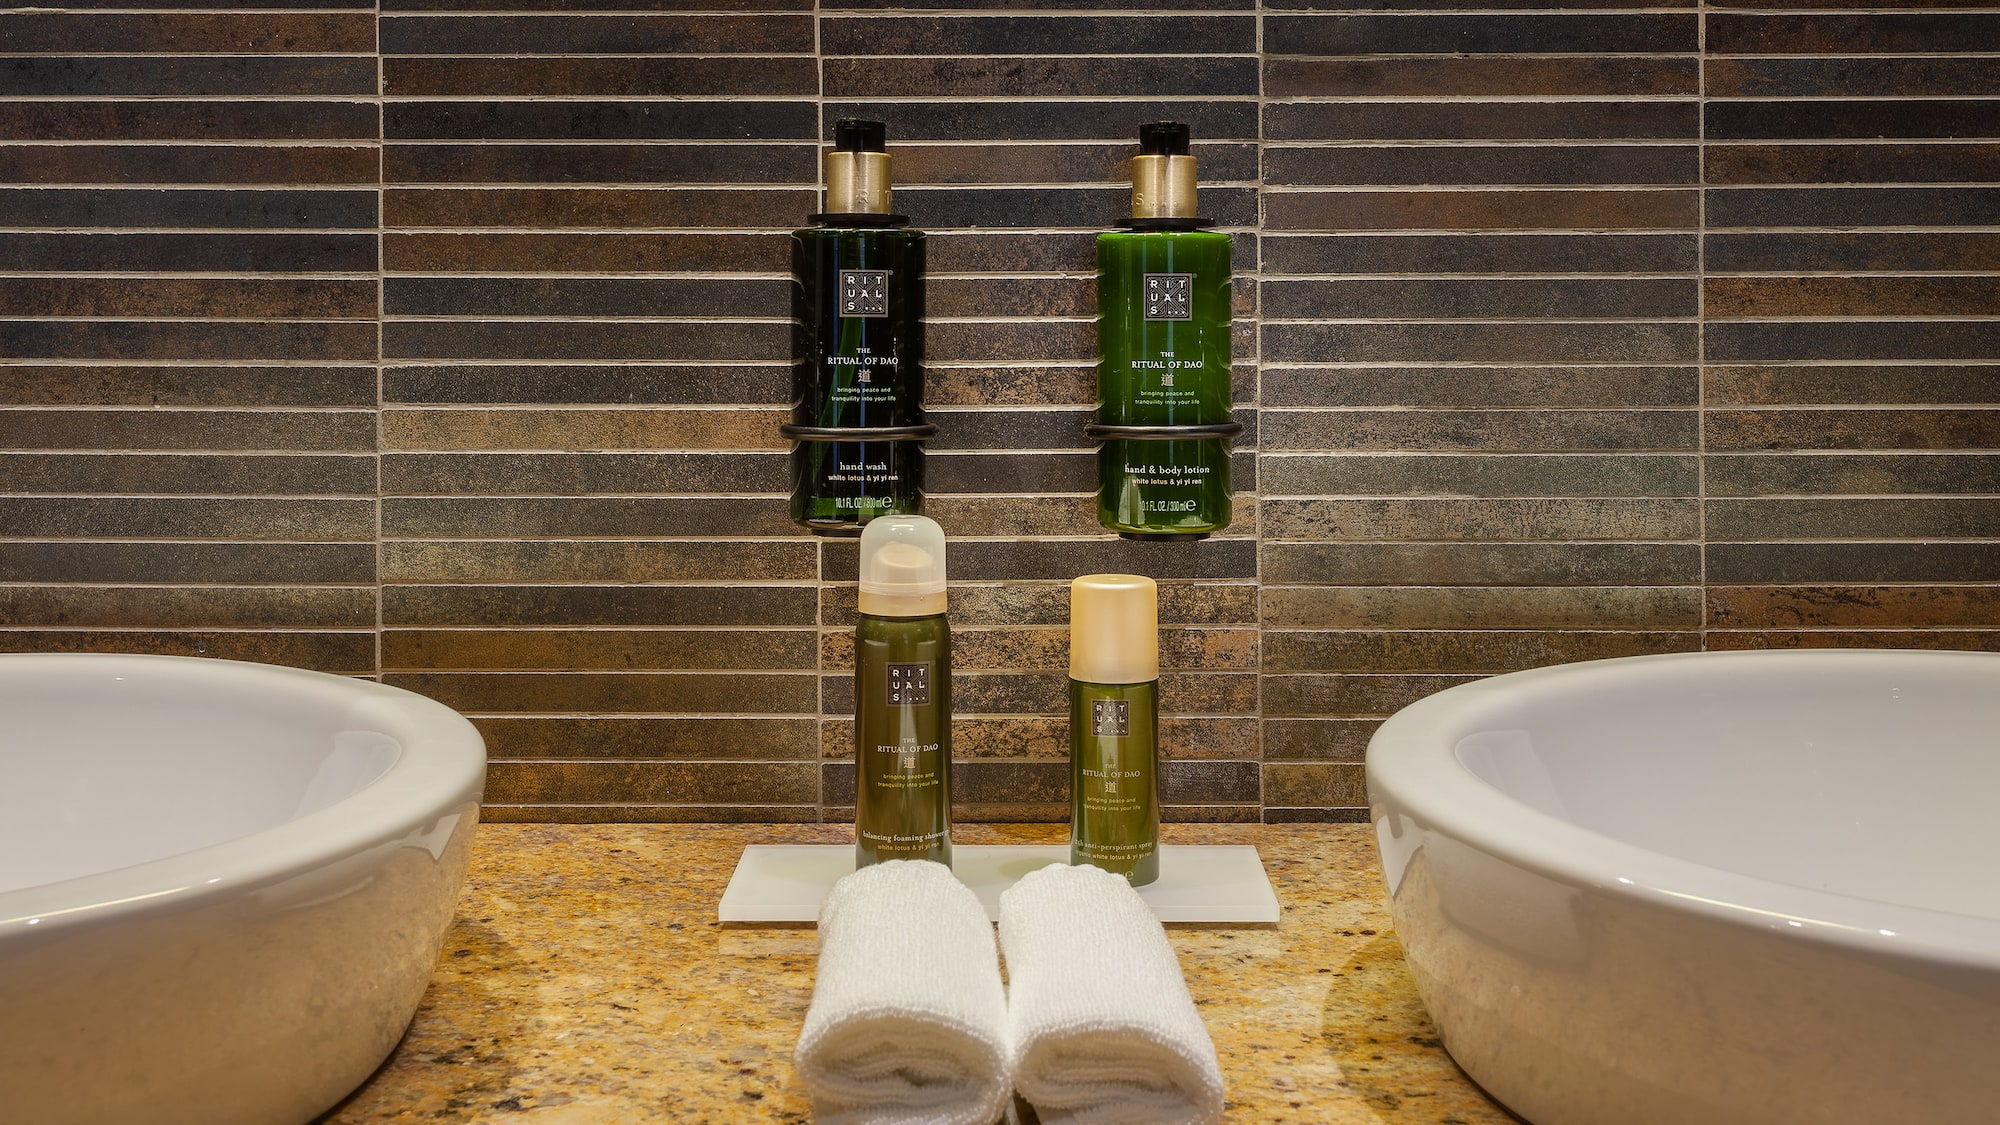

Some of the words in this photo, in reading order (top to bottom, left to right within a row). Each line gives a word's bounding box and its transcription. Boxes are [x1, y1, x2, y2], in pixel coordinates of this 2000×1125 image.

[858, 369, 871, 382] 道
[1161, 373, 1174, 386] 道
[840, 462, 863, 470] hand
[866, 462, 887, 470] wash
[1124, 464, 1146, 473] hand
[1149, 465, 1156, 474] &
[1159, 466, 1181, 476] body
[873, 474, 880, 482] yi
[881, 474, 887, 482] yi
[877, 745, 907, 753] RITUAL
[904, 756, 915, 768] 道
[1082, 769, 1108, 777] RITUAL
[1105, 781, 1116, 793] 道
[862, 830, 892, 843] balancing
[1085, 843, 1137, 852] anti-perspirant
[1139, 842, 1152, 850] spray
